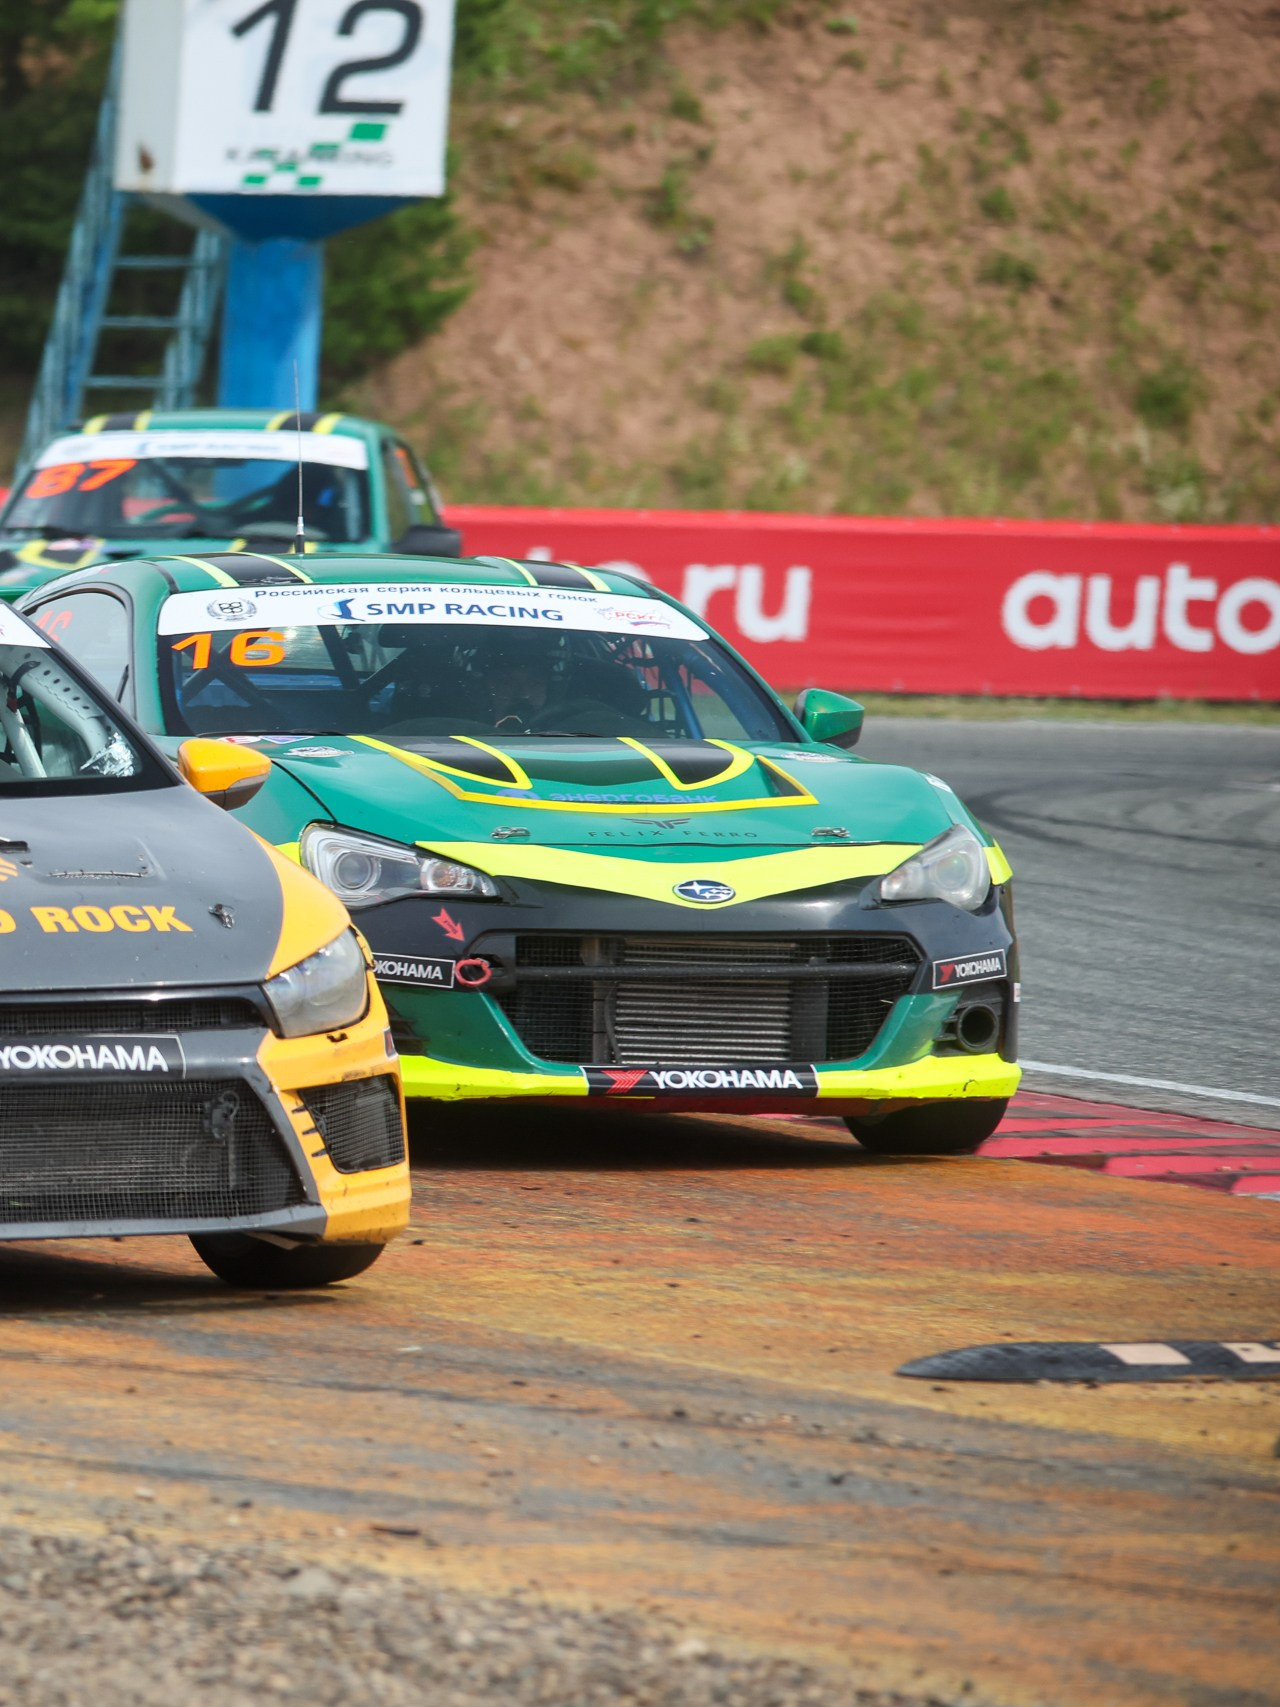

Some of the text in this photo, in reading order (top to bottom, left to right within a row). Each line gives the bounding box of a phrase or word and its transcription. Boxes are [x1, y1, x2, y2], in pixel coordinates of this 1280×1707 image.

[231, 0, 424, 115] 12
[255, 585, 599, 603] Российская серия кольцевых гонок
[367, 602, 564, 622] SMP RACING
[171, 629, 286, 670] 16
[588, 830, 759, 839] FELIX FERRO
[30, 904, 195, 934] ROCK
[373, 959, 444, 980] OKOHAMA
[955, 957, 1002, 978] YOKOHAMA
[649, 1069, 804, 1090] YOKOHAMA
